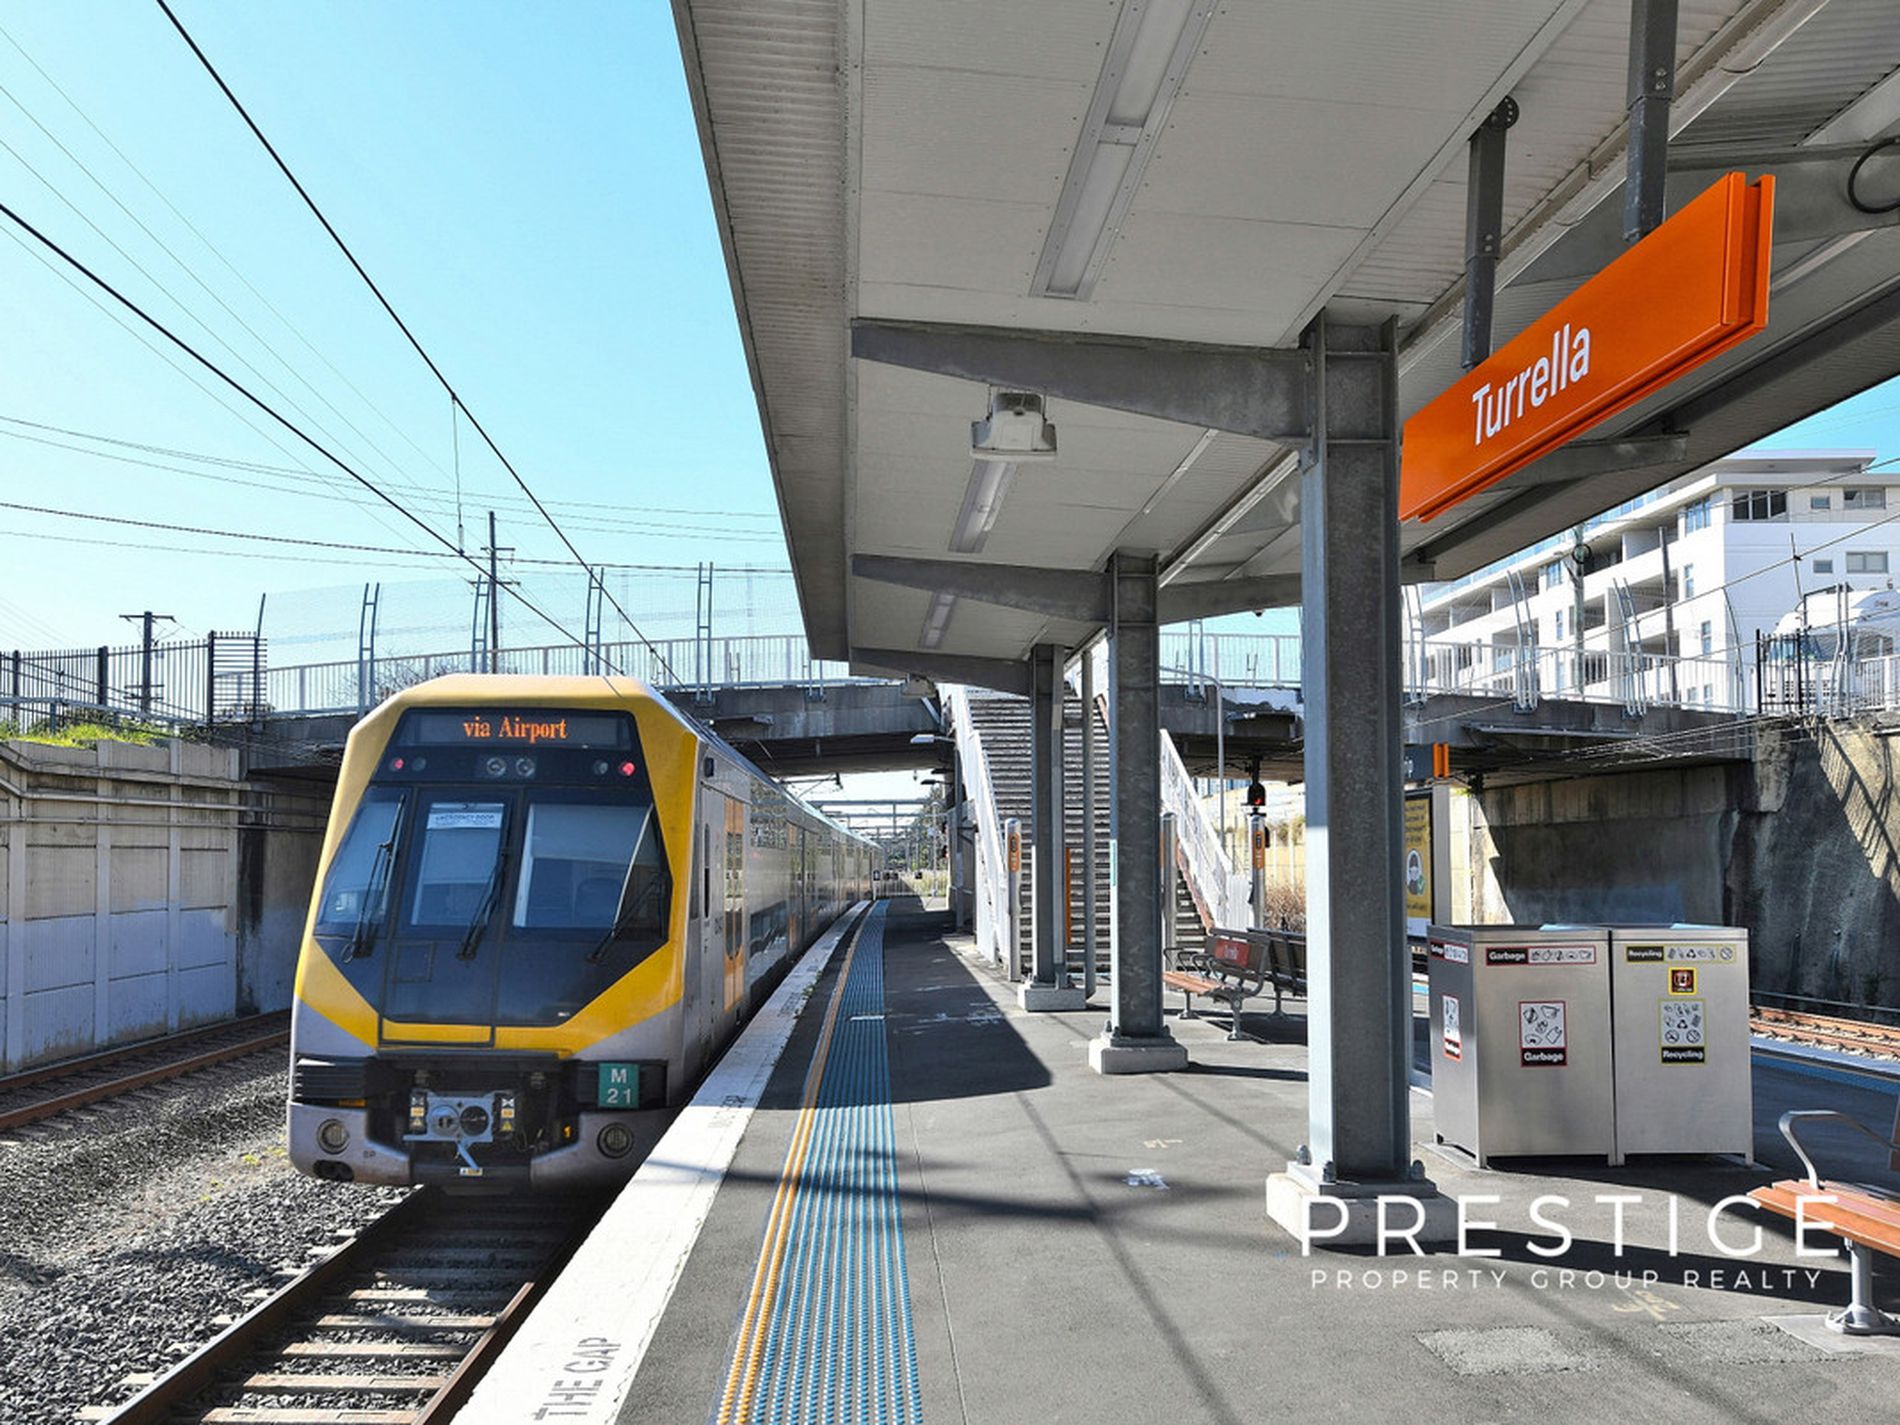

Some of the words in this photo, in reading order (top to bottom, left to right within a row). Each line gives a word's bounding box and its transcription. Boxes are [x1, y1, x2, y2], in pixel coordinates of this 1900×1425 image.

[1472, 323, 1590, 446] Turrella
[463, 716, 491, 737] via
[498, 716, 567, 744] Airport
[1488, 951, 1526, 961] Garbage
[1523, 1052, 1564, 1063] Garbage
[1662, 1050, 1704, 1061] Recycling
[611, 1068, 627, 1083] M
[607, 1088, 631, 1104] 21
[563, 1337, 621, 1373] GAP
[532, 1379, 604, 1421] THE
